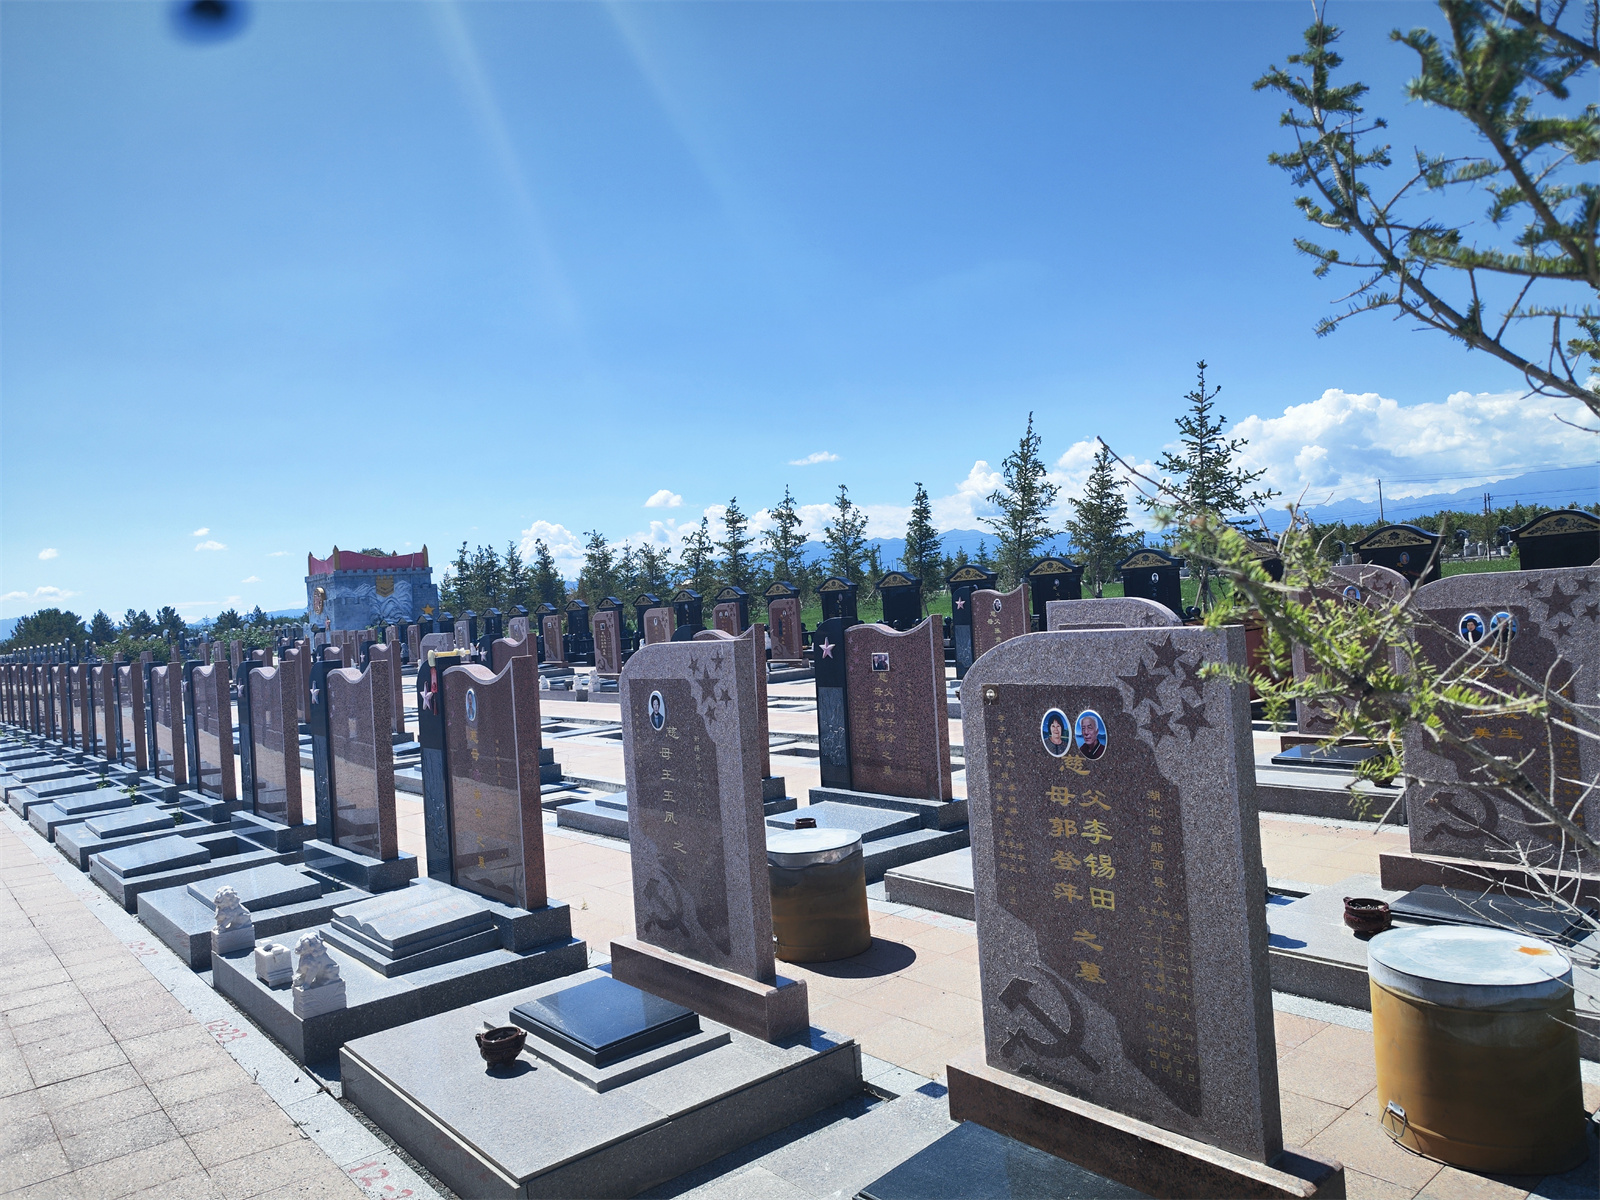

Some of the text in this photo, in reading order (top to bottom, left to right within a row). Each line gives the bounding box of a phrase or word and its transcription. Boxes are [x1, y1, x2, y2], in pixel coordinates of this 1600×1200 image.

[1080, 789, 1116, 911] 父李锡田
[1072, 928, 1107, 985] 之墓
